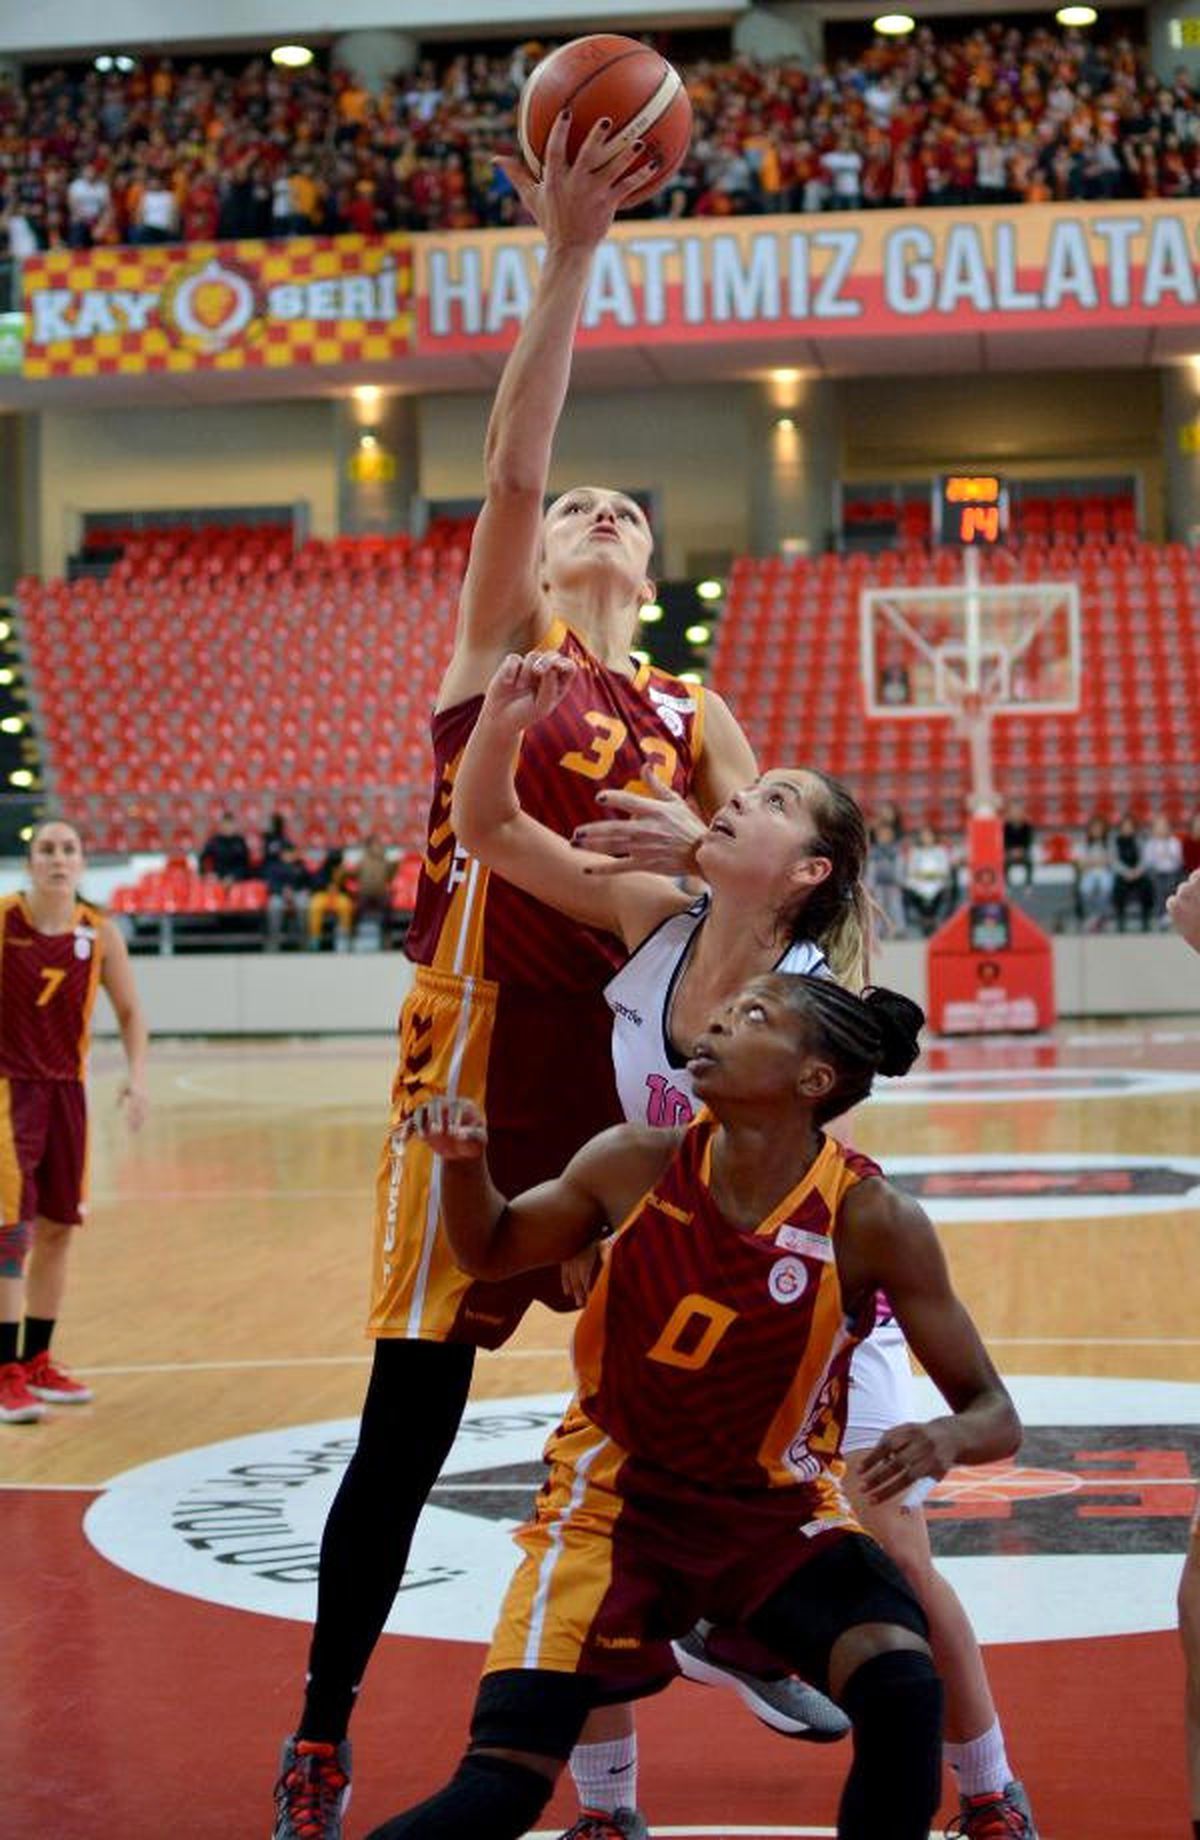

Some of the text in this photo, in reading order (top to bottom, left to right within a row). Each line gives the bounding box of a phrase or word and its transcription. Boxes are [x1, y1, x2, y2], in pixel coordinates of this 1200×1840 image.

[430, 214, 1200, 335] HAATIMIZ GALATA
[32, 288, 161, 344] KAY
[960, 506, 999, 543] 14
[36, 967, 66, 1007] 7
[645, 1293, 739, 1370] 0
